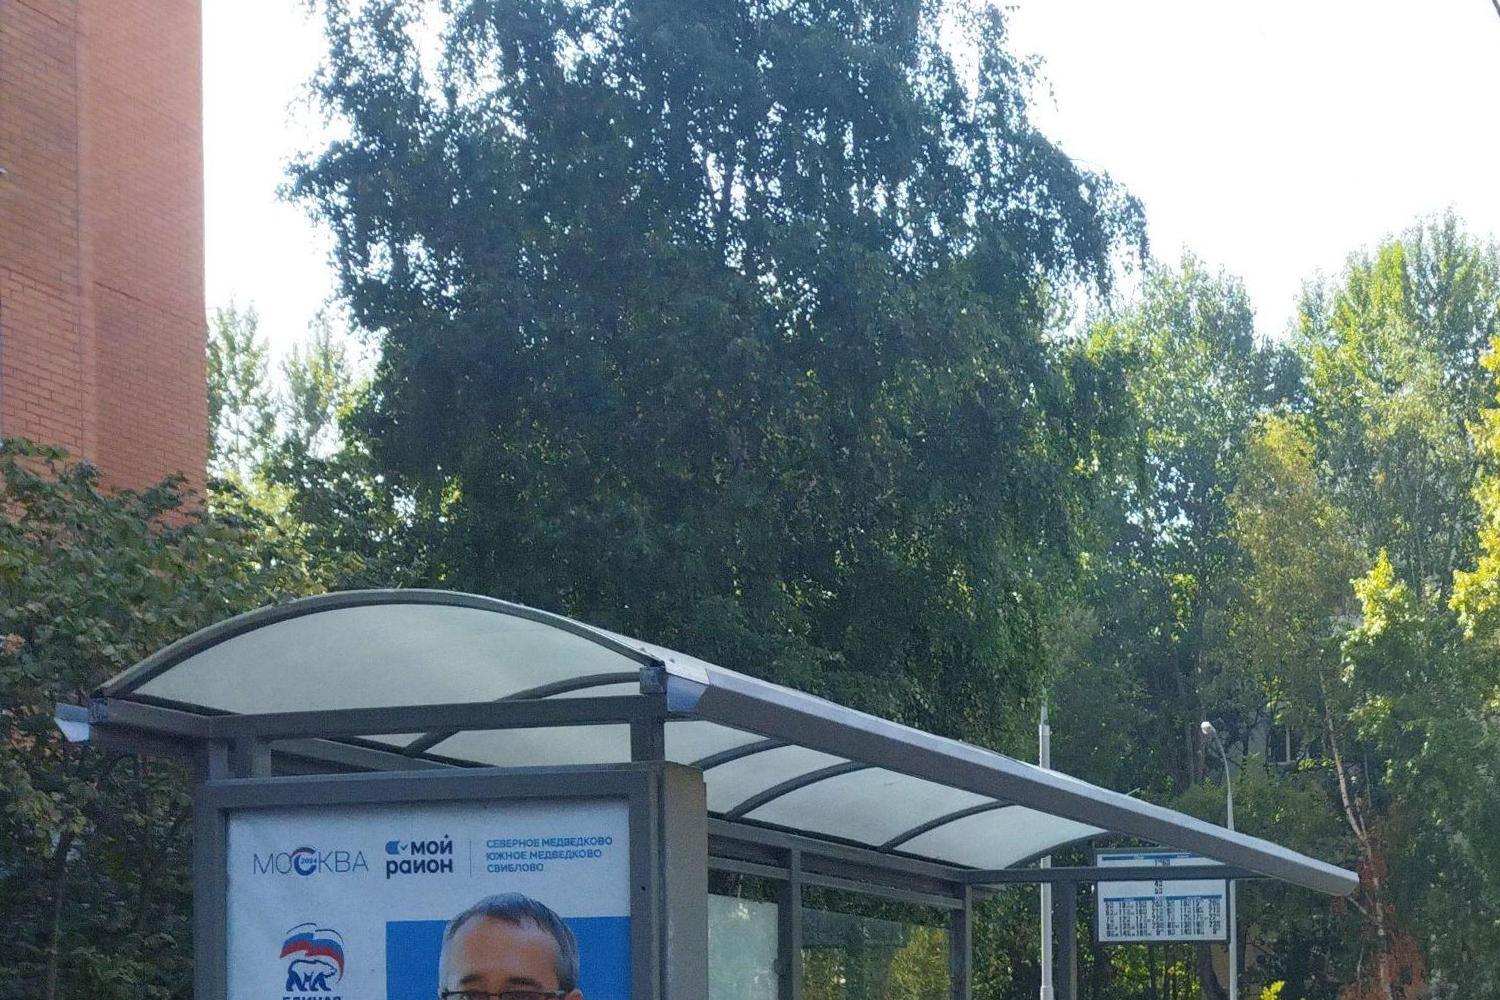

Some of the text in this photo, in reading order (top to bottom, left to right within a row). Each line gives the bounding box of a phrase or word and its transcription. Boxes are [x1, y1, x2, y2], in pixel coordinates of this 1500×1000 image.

[410, 833, 453, 856] мой
[486, 836, 613, 848] СЕВЕРНОЕ МЕДВЕДКОВО
[486, 848, 602, 861] ЮЖНОЕ МЕДВЕДКОВО
[252, 847, 369, 876] МОСКВА
[486, 863, 544, 872] СВИБЛОВО
